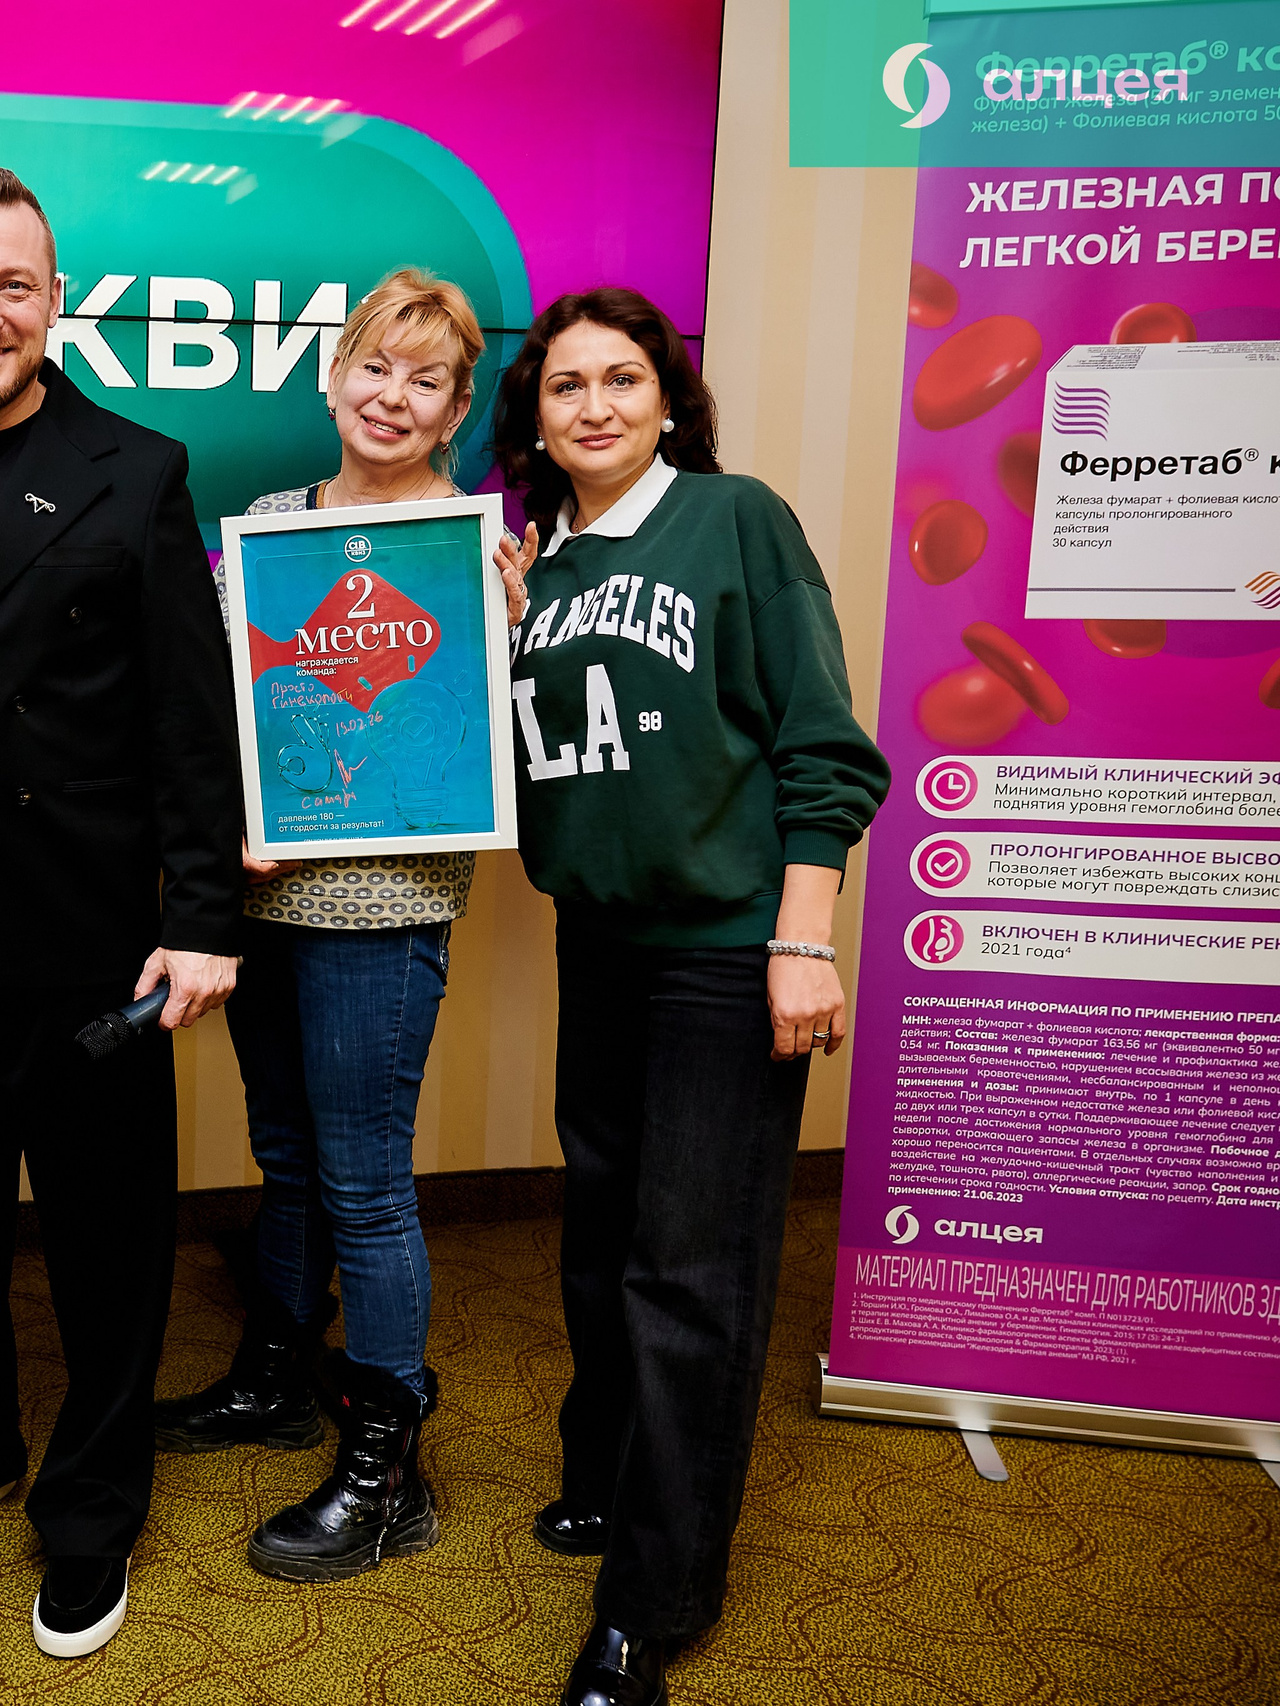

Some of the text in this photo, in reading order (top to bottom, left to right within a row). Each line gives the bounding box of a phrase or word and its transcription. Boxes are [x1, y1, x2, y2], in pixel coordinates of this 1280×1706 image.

[973, 94, 1059, 115] Фумарат
[1064, 92, 1138, 109] железа
[1180, 90, 1204, 103] мг
[971, 114, 1049, 134] железа)
[1072, 111, 1170, 128] Фолиевая
[1176, 107, 1257, 125] кислота
[965, 171, 1280, 213] ЖЕЛЕЗНАЯ П
[959, 225, 1280, 268] ЛЕГКОЙ БЕРЕ
[1056, 495, 1103, 505] Железа
[1106, 494, 1162, 506] фумарат
[1177, 494, 1239, 506] фолиевая
[1055, 509, 1233, 520] капсулы пролонгированного
[1053, 524, 1109, 535] действия
[1052, 538, 1112, 549] 30 капсул
[346, 574, 375, 620] 2
[524, 574, 696, 674] ANGELES
[295, 655, 359, 668] награждается
[296, 667, 337, 677] команда:
[512, 664, 630, 781] LA
[638, 710, 662, 732] 98
[996, 765, 1098, 783] ВИДИМЫЙ
[1103, 765, 1253, 784] КЛИНИЧЕСКИЙ
[994, 782, 1276, 805] Минимально короткий интервал,
[278, 814, 318, 823] давление
[319, 812, 334, 820] 180
[993, 799, 1065, 814] поднятия
[1069, 801, 1126, 816] уровня
[1130, 800, 1234, 815] гемоглобина
[290, 823, 328, 833] гордости
[341, 820, 384, 830] результат!
[990, 843, 1206, 864] ПРОЛОНГИРОВАННОЕ
[988, 860, 1077, 876] Позволяет
[1081, 864, 1164, 880] избежать
[1168, 870, 1240, 882] высоких
[986, 876, 1057, 892] которые
[1061, 880, 1107, 894] могут
[1113, 882, 1218, 898] повреждать
[981, 942, 1020, 955] 2021
[982, 924, 1079, 942] ВКЛЮЧЕН
[1084, 930, 1096, 943] В
[1102, 930, 1246, 949] КЛИНИЧЕСКИЕ
[903, 995, 1004, 1013] СОКРАЩЕННАЯ
[1006, 1001, 1108, 1018] ИНФОРМАЦИЯ
[1110, 1006, 1132, 1017] ПО
[1134, 1007, 1234, 1021] ПРИМЕНЕНИЮ
[900, 1025, 951, 1041] действия;
[954, 1028, 998, 1041] Состав:
[1000, 1033, 1044, 1044] железа
[1047, 1033, 1098, 1049] фумарат
[1143, 1041, 1158, 1050] мг
[1161, 1039, 1244, 1056] (эквивалентно
[1248, 1044, 1263, 1055] 50
[1266, 1047, 1280, 1056] мг
[901, 1013, 932, 1025] МНН:
[932, 1017, 972, 1027] железа
[974, 1017, 1024, 1032] фумарат
[1035, 1020, 1092, 1036] фолиевая
[1094, 1026, 1142, 1038] кислота;
[1143, 1028, 1234, 1043] лекарственная
[898, 1053, 966, 1065] вызываемых
[1060, 1062, 1132, 1076] нарушением
[1134, 1066, 1203, 1078] всасывания
[1205, 1070, 1248, 1080] железа
[1250, 1072, 1264, 1081] из
[926, 1041, 940, 1050] мг.
[944, 1040, 1009, 1054] Показания
[1013, 1046, 1022, 1055] к
[1026, 1047, 1105, 1062] применению:
[1109, 1052, 1157, 1062] лечение
[1162, 1054, 1170, 1063] и
[1174, 1053, 1258, 1070] профилактика
[897, 1064, 968, 1079] длительными
[1079, 1073, 1204, 1092] несбалансированным
[1212, 1083, 1220, 1091] и
[888, 1172, 902, 1181] по
[903, 1173, 958, 1186] истечении
[959, 1178, 992, 1191] срока
[994, 1180, 1046, 1195] годности.
[1049, 1182, 1097, 1196] Условия
[1098, 1188, 1149, 1202] отпуска:
[1150, 1192, 1165, 1201] по
[1166, 1193, 1213, 1206] рецепту.
[1215, 1194, 1247, 1208] Дата
[889, 1160, 937, 1174] желудке,
[939, 1164, 988, 1178] тошнота,
[991, 1166, 1030, 1181] рвота),
[1032, 1171, 1116, 1188] аллергические
[1118, 1177, 1169, 1191] реакции,
[1172, 1181, 1208, 1193] запор.
[1210, 1181, 1241, 1195] Срок
[888, 1185, 1023, 1202] применению: 21.06.2023
[933, 1218, 1044, 1244] алцея
[855, 1253, 946, 1291] МАТЕРИАЛ
[949, 1260, 1090, 1304] ПРЕДНАЗНАЧЕН
[1090, 1272, 1131, 1312] ДЛЯ
[1133, 1276, 1256, 1317] РАБОТНИКОВ
